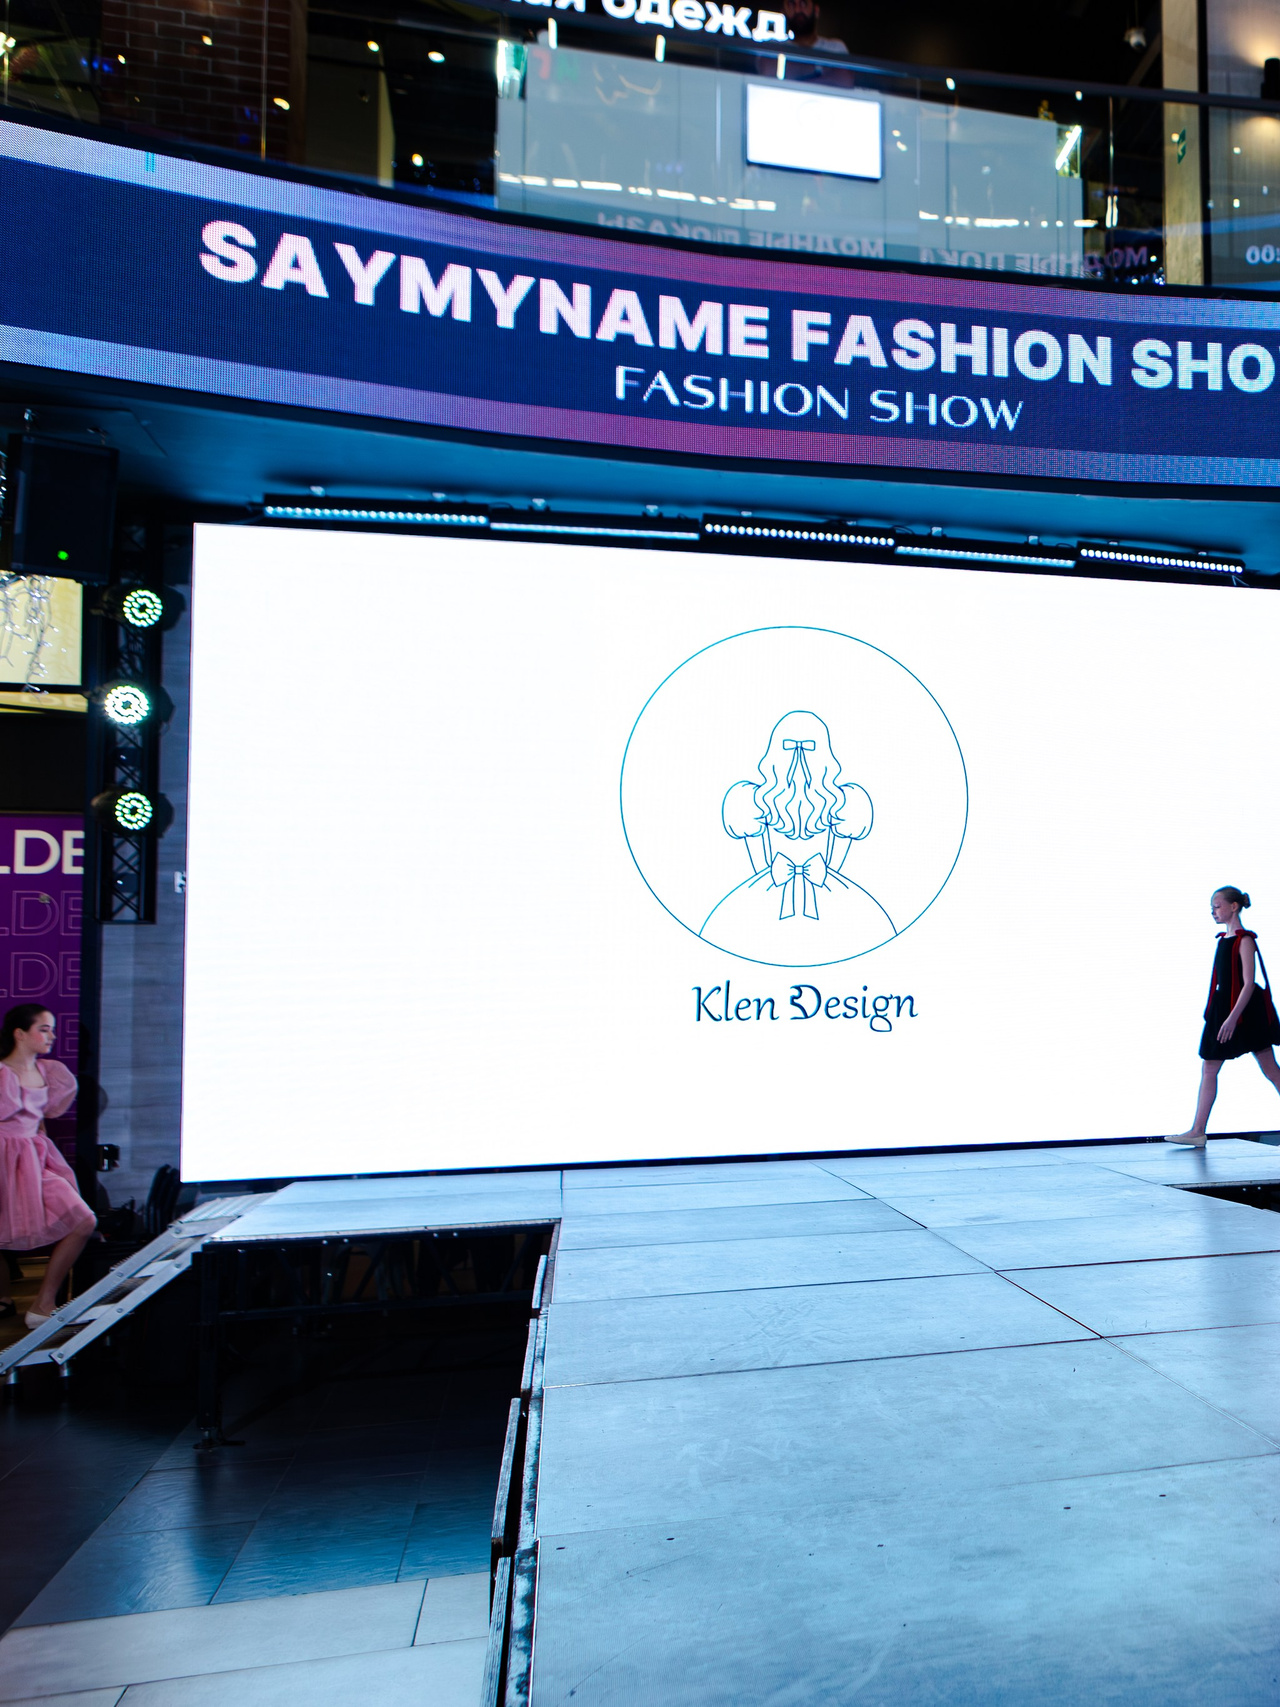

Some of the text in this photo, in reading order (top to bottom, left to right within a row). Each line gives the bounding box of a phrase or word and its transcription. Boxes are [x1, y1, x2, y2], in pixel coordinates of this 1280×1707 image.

[199, 219, 771, 361] SAYMYNAME
[790, 309, 1112, 387] FASHION
[615, 364, 1024, 431] FASHION SHOW
[691, 980, 919, 1033] Klen Design
